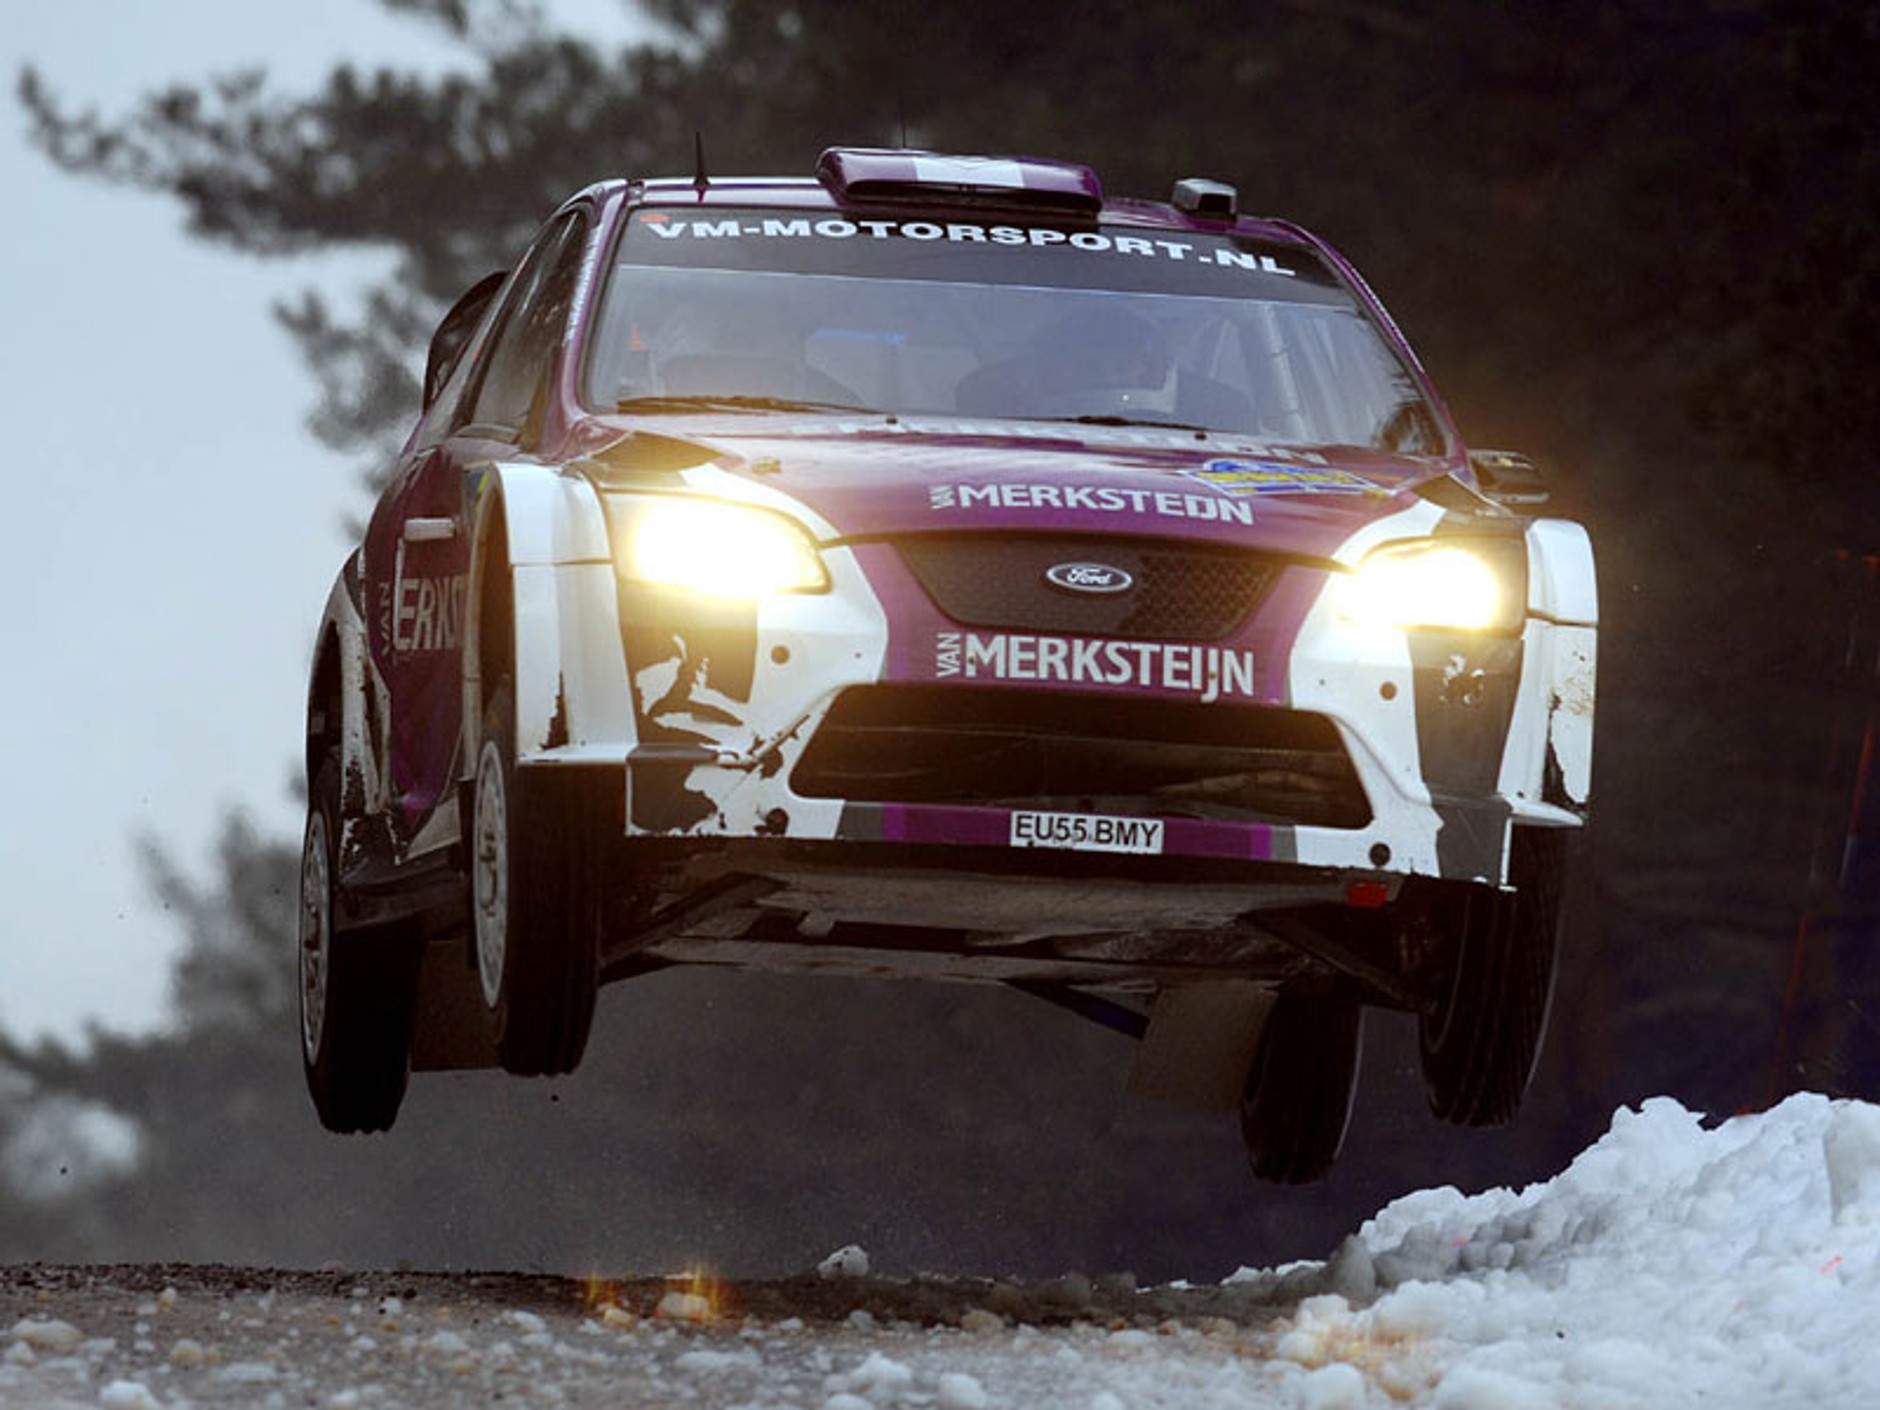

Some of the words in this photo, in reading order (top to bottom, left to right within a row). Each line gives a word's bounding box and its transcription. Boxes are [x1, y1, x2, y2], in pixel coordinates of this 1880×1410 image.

[646, 219, 1296, 277] VM-MOTORSPORT.NL
[1066, 568, 1112, 585] Ford
[937, 633, 960, 678] VAN
[965, 634, 1254, 702] MERKSTEIJN
[1015, 814, 1087, 843] EU55
[1094, 820, 1159, 847] BMY
